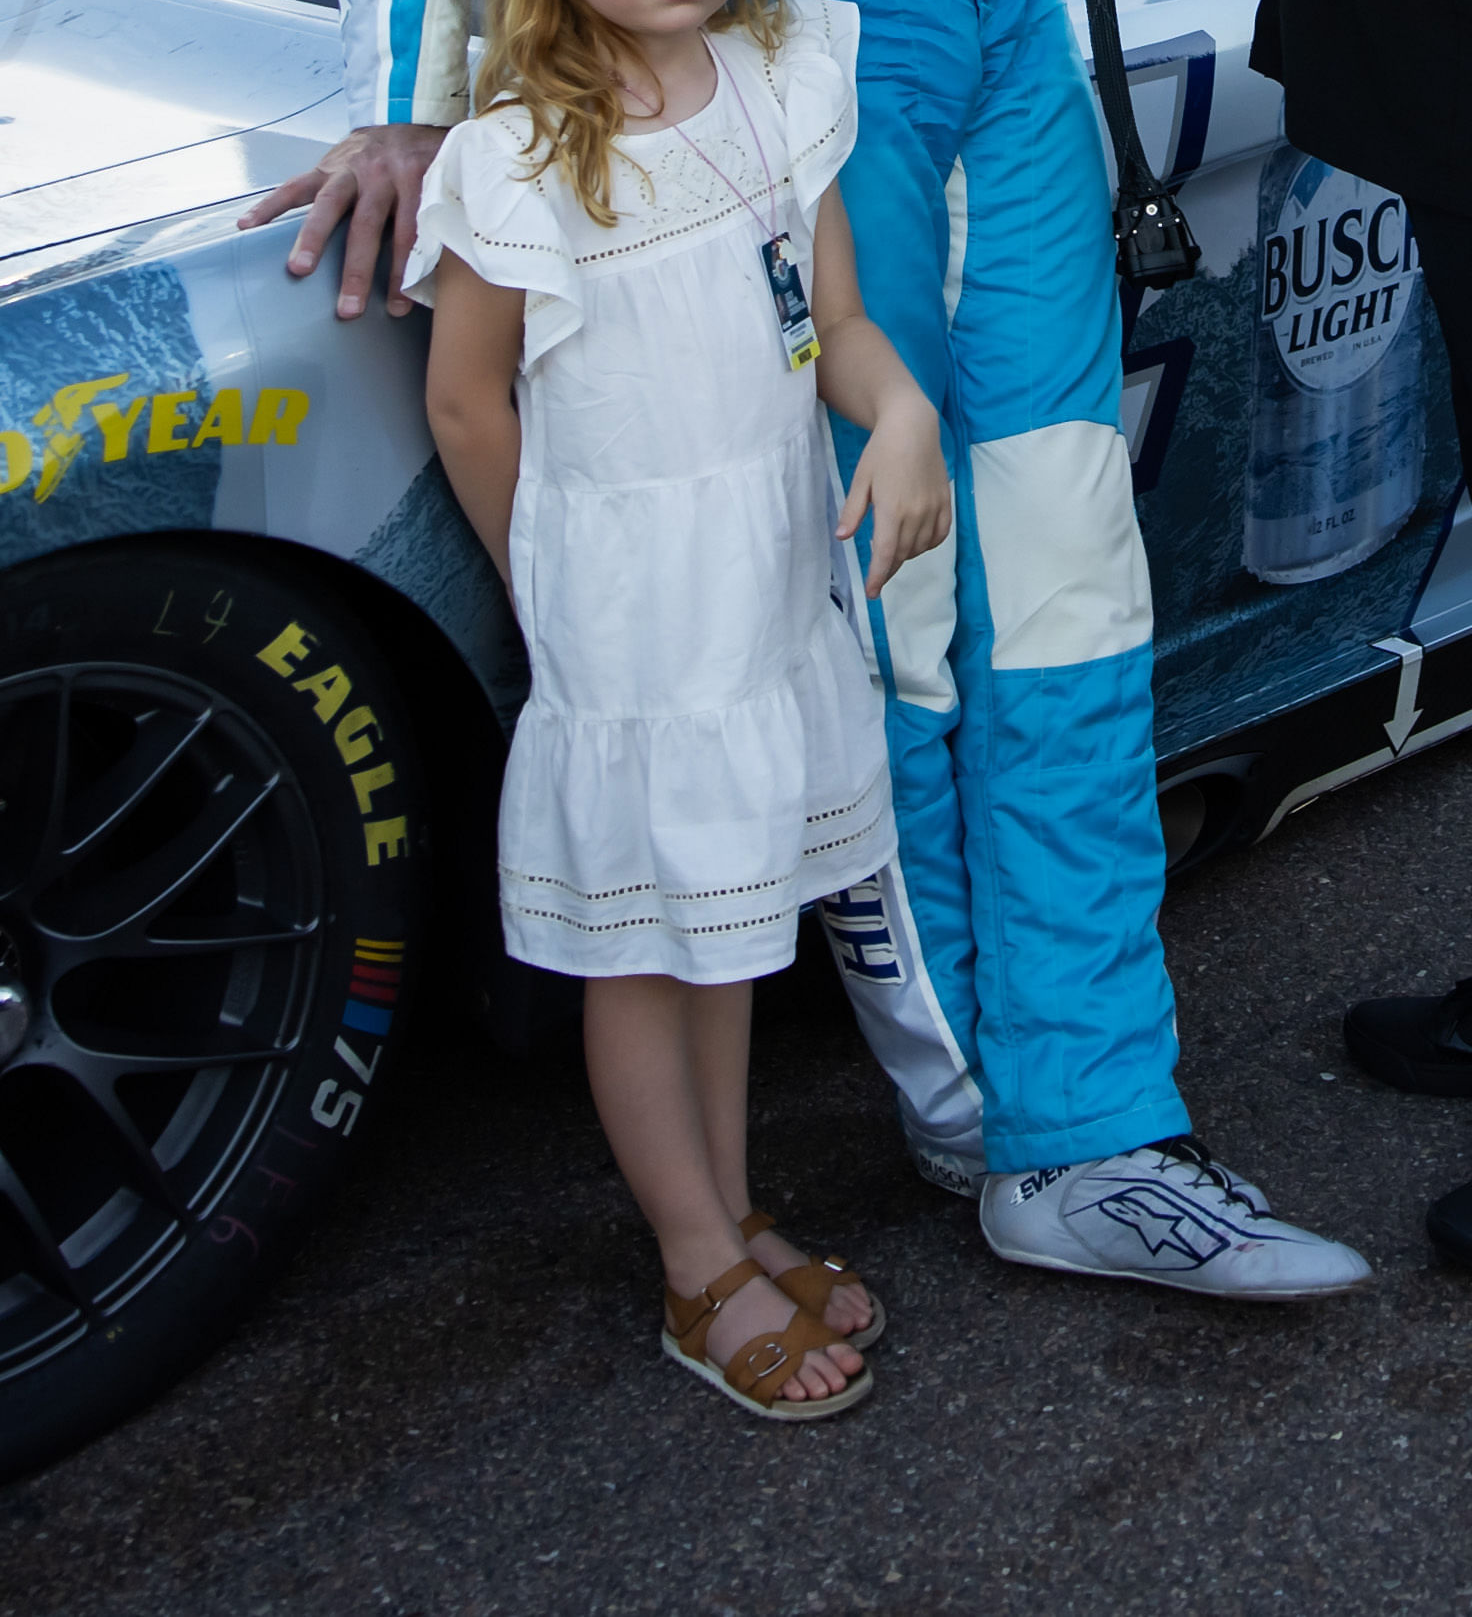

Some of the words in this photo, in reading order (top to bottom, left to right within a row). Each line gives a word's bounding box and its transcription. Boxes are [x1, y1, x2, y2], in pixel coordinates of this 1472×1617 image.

[1288, 283, 1401, 354] LIGHT
[1300, 350, 1335, 368] BREWED
[1352, 340, 1362, 352] IN
[1325, 514, 1340, 530] FL
[1341, 508, 1357, 524] OZ
[255, 620, 410, 868] EAGLE
